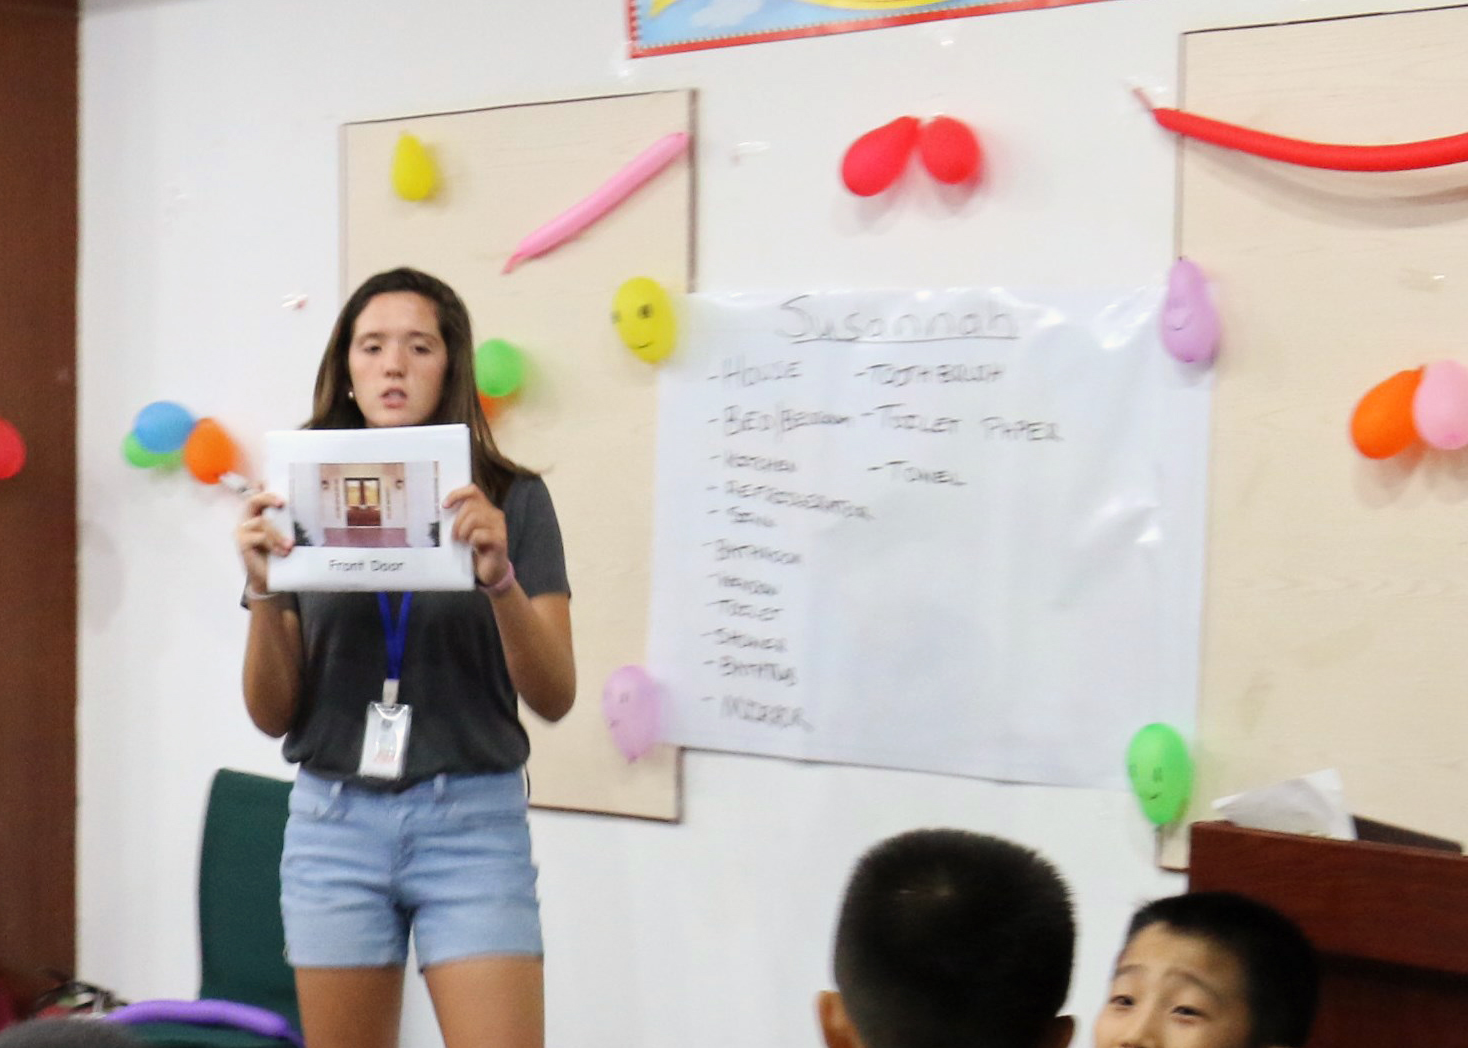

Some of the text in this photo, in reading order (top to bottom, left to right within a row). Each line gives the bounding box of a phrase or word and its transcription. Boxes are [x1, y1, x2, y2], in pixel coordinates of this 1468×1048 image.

[775, 294, 1018, 343] Susannah
[329, 559, 404, 572] Front Door
